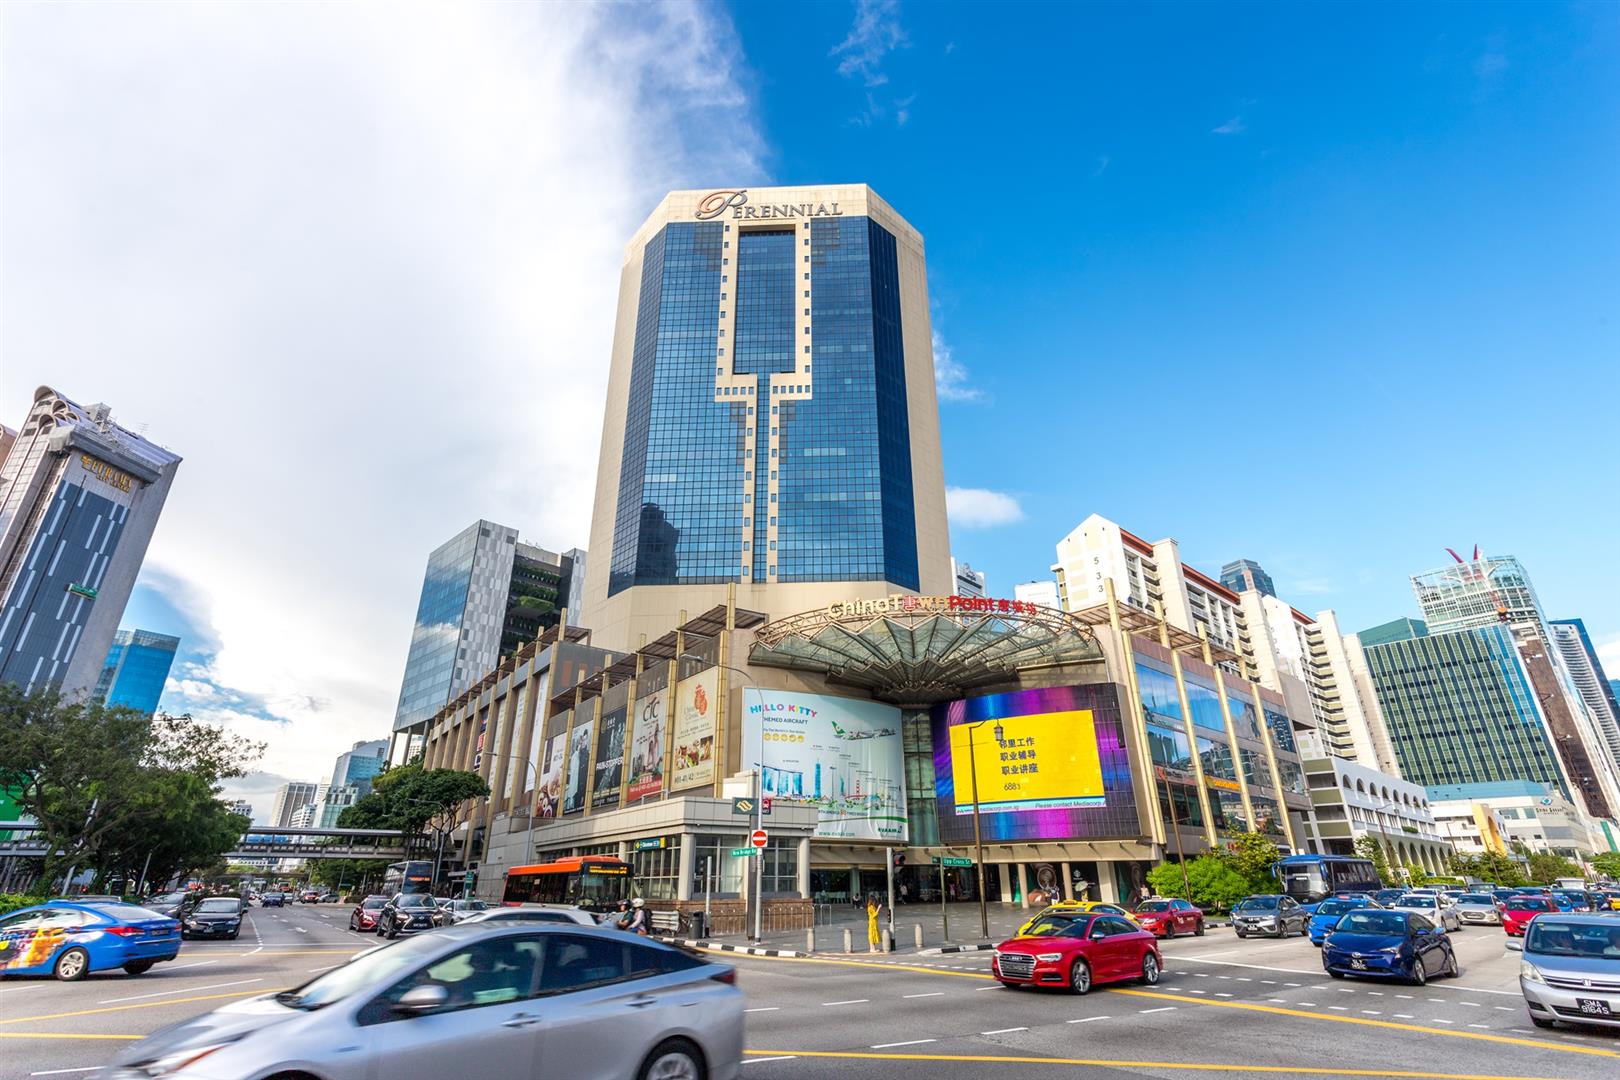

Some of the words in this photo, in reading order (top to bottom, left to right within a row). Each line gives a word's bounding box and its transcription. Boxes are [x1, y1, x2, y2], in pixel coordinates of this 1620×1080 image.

[694, 189, 843, 220] PERENNIAL
[949, 595, 995, 612] Point
[788, 704, 818, 718] KITTY
[1000, 750, 1036, 761] 职业辅导
[1001, 763, 1039, 775] 职业讲座
